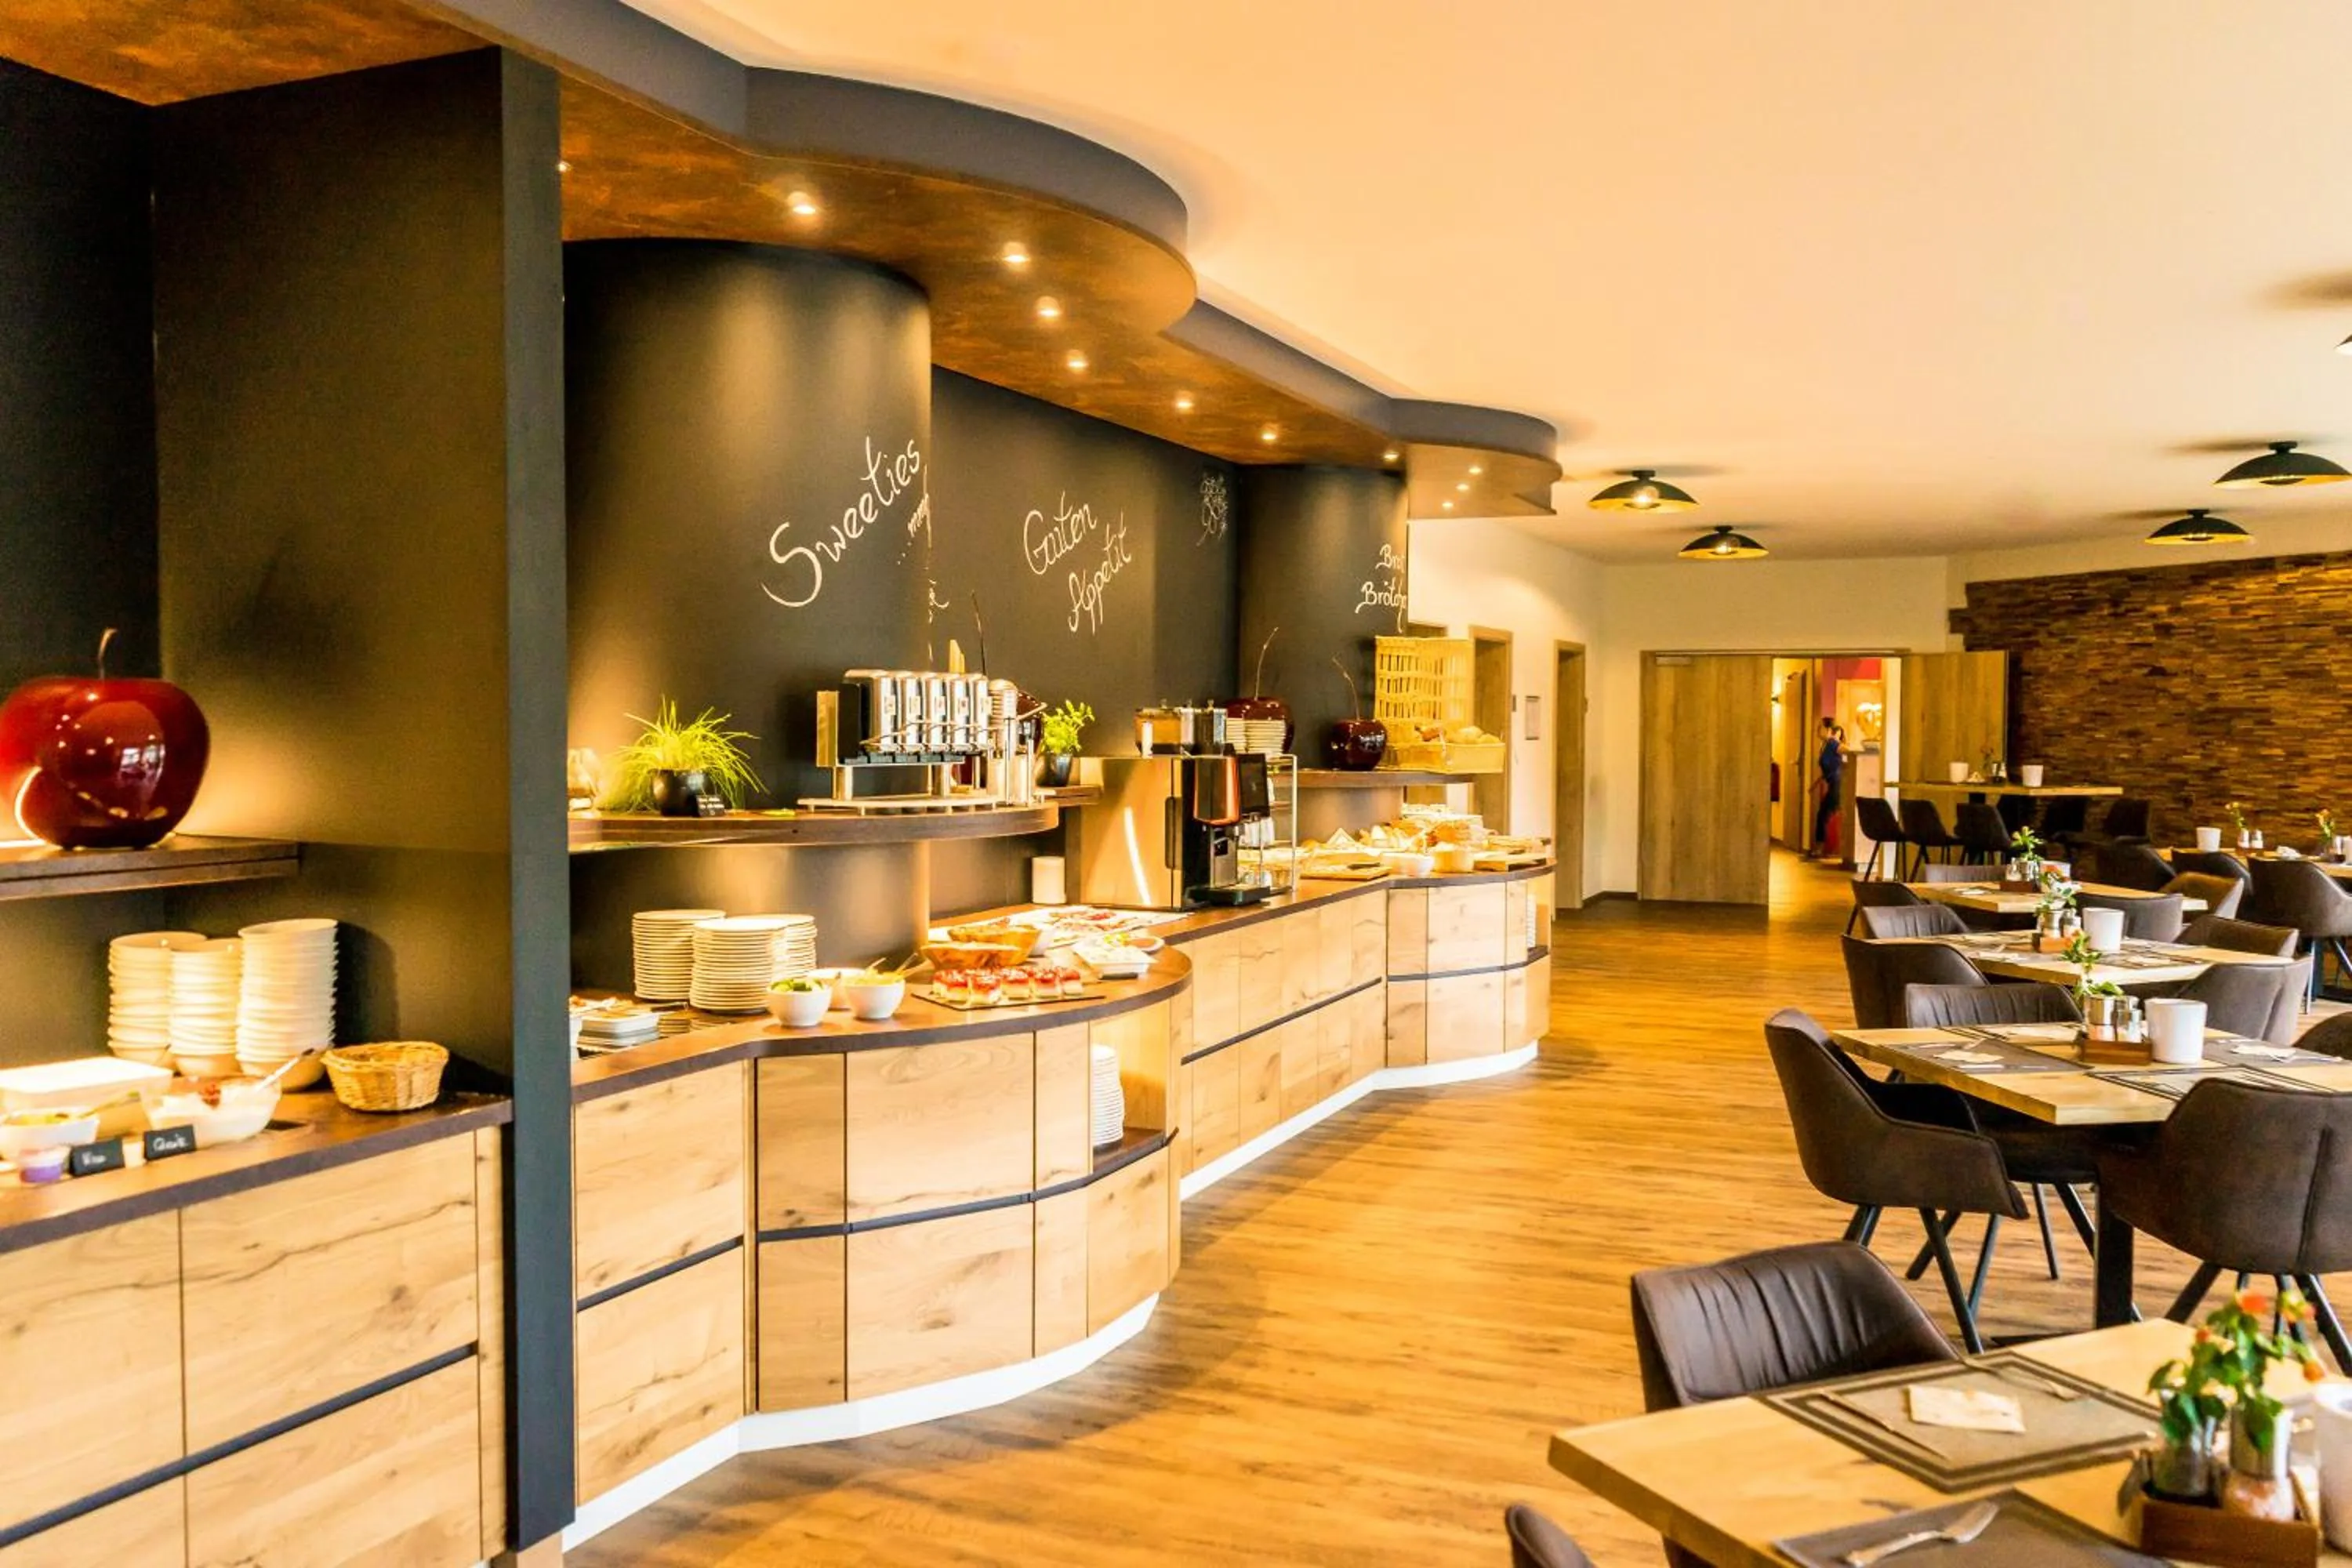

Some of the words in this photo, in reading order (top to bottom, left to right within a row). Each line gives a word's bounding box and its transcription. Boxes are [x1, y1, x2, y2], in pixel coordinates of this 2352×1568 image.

[760, 436, 920, 608] Sweeties
[1023, 490, 1098, 575] Guten
[1068, 510, 1132, 635] Appetit
